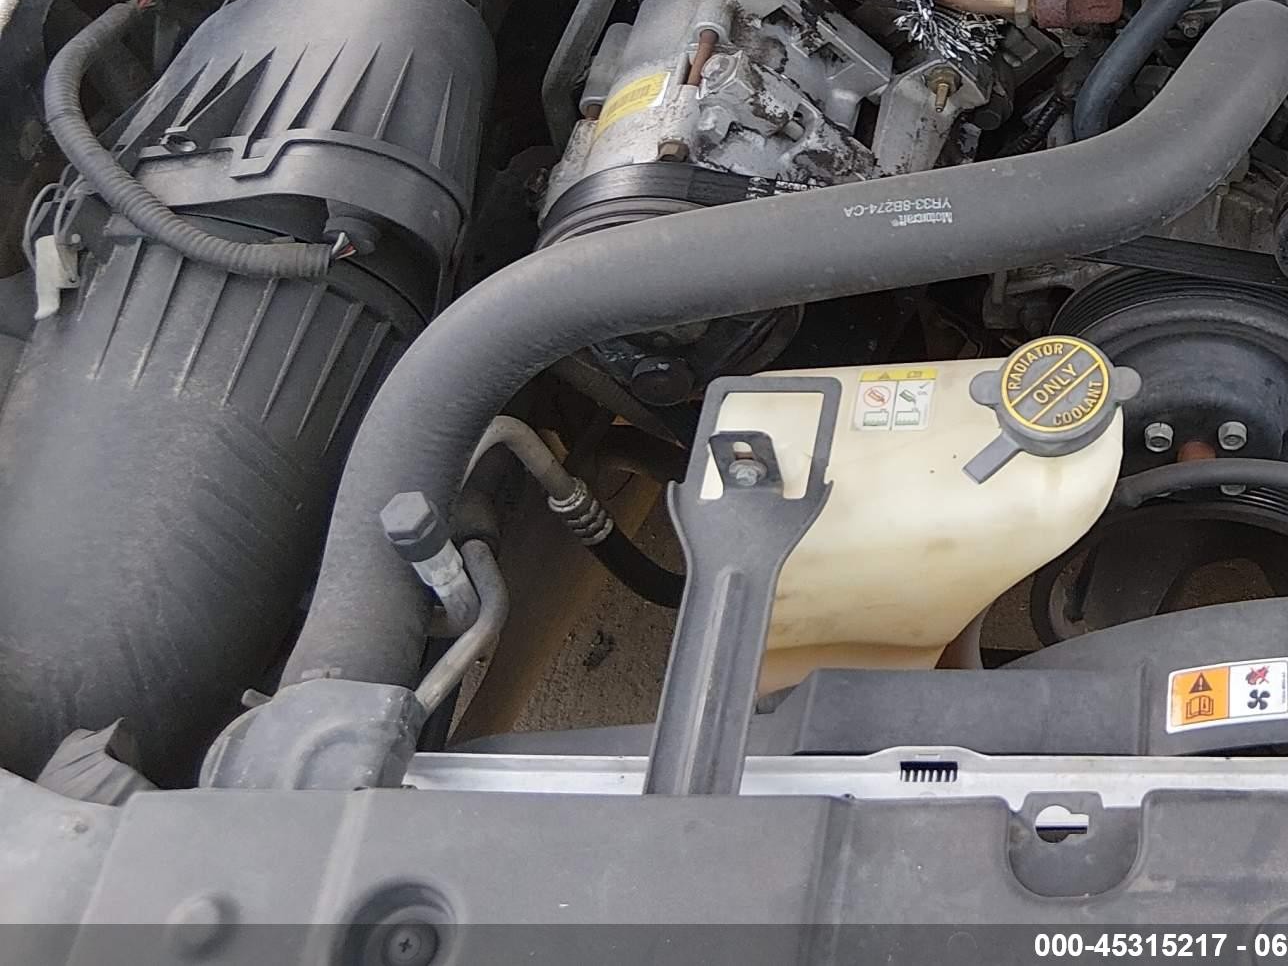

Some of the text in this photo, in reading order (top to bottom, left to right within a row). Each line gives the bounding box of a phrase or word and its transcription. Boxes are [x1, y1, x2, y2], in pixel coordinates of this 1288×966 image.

[1007, 342, 1063, 392] RADIATOR
[1033, 363, 1078, 405] ONLY
[1053, 380, 1103, 426] COOLANT
